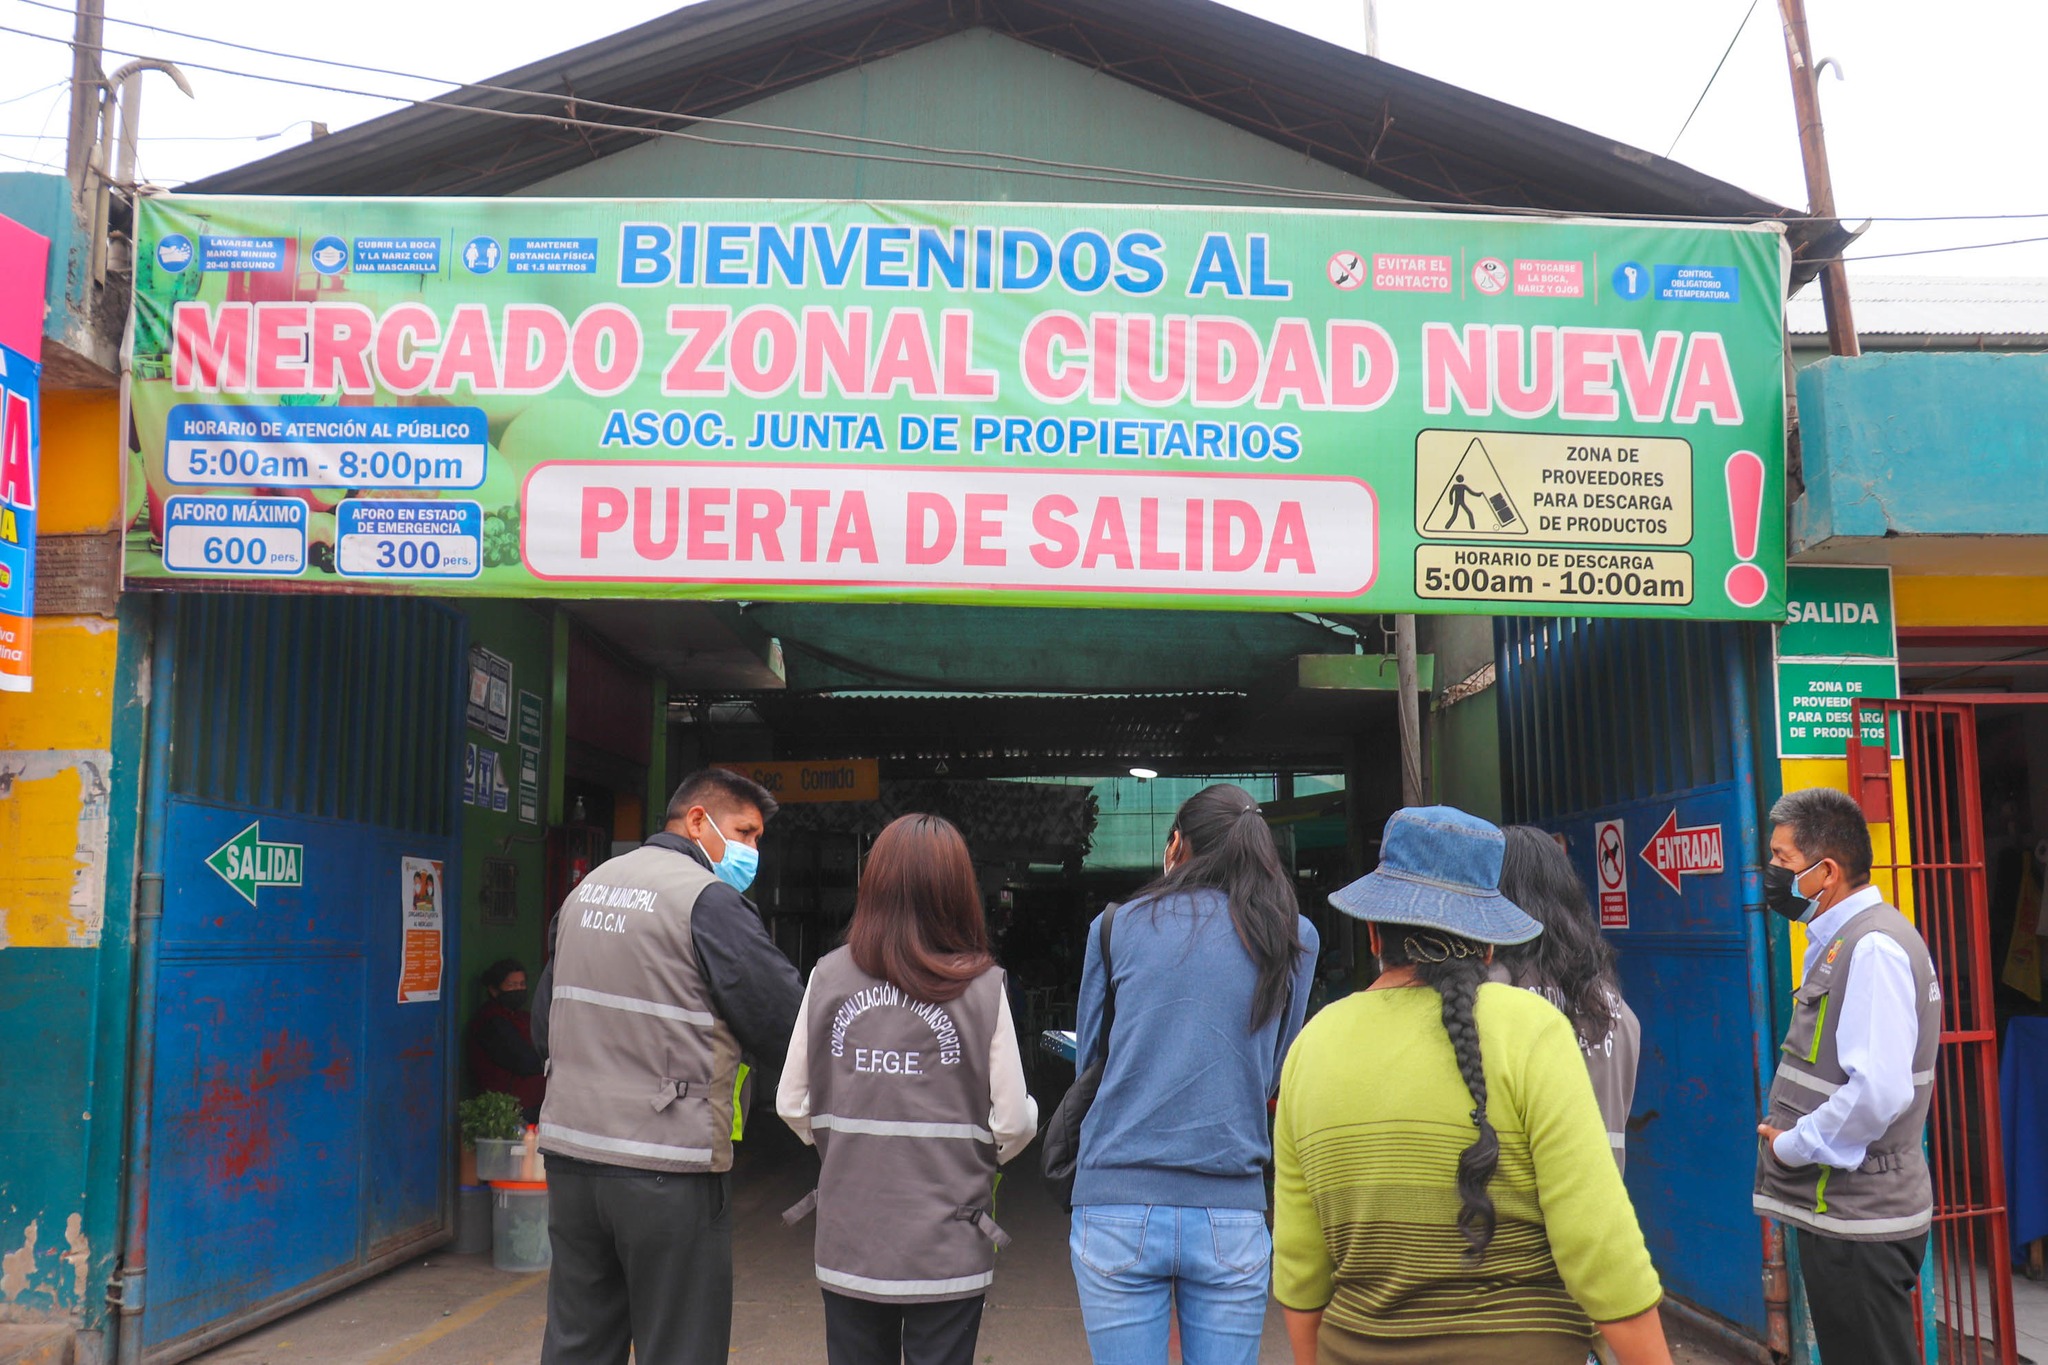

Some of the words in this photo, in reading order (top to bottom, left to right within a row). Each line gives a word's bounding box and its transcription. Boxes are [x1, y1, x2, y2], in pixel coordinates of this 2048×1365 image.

[211, 239, 252, 248] LAVARSE
[255, 240, 274, 249] LAS
[357, 241, 393, 249] CUBRIR
[395, 241, 408, 249] LA
[410, 241, 437, 249] BOCA
[526, 241, 580, 249] MANTENER
[206, 250, 239, 258] MANOS
[240, 250, 277, 259] MINIMO
[359, 252, 367, 260] Y
[368, 252, 380, 260] LA
[382, 252, 411, 260] NARIZ
[413, 252, 433, 260] CON
[509, 252, 561, 260] DISTANCIA
[563, 250, 595, 260] FÍSICA
[620, 223, 1166, 294] BIENVENIDOS
[1188, 234, 1290, 298] AL
[206, 261, 229, 269] 20-40
[230, 261, 275, 270] SEGUNDO
[355, 263, 375, 271] UNA
[377, 263, 437, 271] MASCARILLA
[516, 263, 529, 271] DE
[531, 263, 545, 271] 1.5
[547, 263, 587, 271] METROS
[1377, 258, 1426, 271] EVITAR
[1430, 259, 1446, 272] EL
[1519, 262, 1532, 271] NO
[1535, 263, 1576, 273] TOCARSE
[1376, 274, 1448, 289] CONTACTO
[1527, 274, 1540, 282] LA
[1678, 269, 1714, 279] CONTROL
[1517, 284, 1545, 293] NARIZ
[1546, 285, 1554, 293] Y
[1555, 285, 1580, 294] OJOS
[1671, 279, 1721, 289] OBLIGATORIO
[1663, 289, 1673, 298] DE
[1674, 289, 1730, 299] TEMPERATURA
[175, 303, 641, 397] MERCADO
[665, 307, 998, 399] ZONAL
[1022, 311, 1398, 411] CIUDAD
[1423, 322, 1744, 425] NUEVA
[184, 420, 257, 437] HORARIO
[261, 422, 282, 437] DE
[285, 420, 367, 438] ATENCIÓN
[371, 423, 393, 438] AL
[397, 420, 470, 438] PÚBLICO
[601, 411, 735, 447] ASOC.
[747, 412, 885, 451] JUNTA
[899, 416, 960, 453] DE
[974, 417, 1301, 461] PROPIETARIOS
[1566, 446, 1612, 463] ZONA
[1618, 448, 1640, 463] DE
[188, 448, 309, 477] 5:00am
[339, 450, 463, 484] 8:00pm
[1541, 469, 1664, 487] PROVEEDORES
[1533, 492, 1578, 509] PARA
[1583, 493, 1673, 512] DESCARGA
[171, 503, 227, 521] AFORO
[232, 501, 301, 523] MÁXIMO
[352, 508, 395, 520] AFORO
[398, 509, 415, 520] EN
[418, 509, 467, 521] ESTADO
[357, 522, 375, 533] DE
[378, 522, 461, 534] EMERGENCIA
[580, 486, 879, 565] PUERTA
[905, 491, 1008, 567] DE
[1029, 493, 1317, 575] SALIDA
[1539, 516, 1561, 531] DE
[1566, 516, 1668, 534] PRODUCTOS
[203, 537, 267, 564] 600
[270, 553, 299, 565] pers.
[376, 540, 440, 568] 300
[443, 555, 472, 567] pers.
[1454, 551, 1531, 567] HORARIO
[1537, 552, 1559, 568] DE
[1564, 553, 1654, 570] DESCARGA
[1425, 567, 1533, 593] 5:00am
[1559, 571, 1684, 597] 10:00am
[1786, 601, 1879, 624] SALIDA
[1808, 681, 1843, 692] ZONA
[1846, 682, 1862, 692] DE
[1793, 696, 1852, 707] PROVEED
[1788, 711, 1822, 722] PARA
[1790, 727, 1806, 738] DE
[1813, 727, 1885, 738] PRODUTOS
[1655, 832, 1721, 870] ENTRADA
[226, 844, 297, 881] SALIDA
[606, 887, 658, 912] MUNICIPAL
[580, 909, 626, 933] M.D.C.N.
[831, 981, 899, 1058] COMERCIALIZACIÓN
[902, 994, 909, 1008] Y
[910, 1000, 961, 1065] TRANSPORTES
[855, 1048, 924, 1075] E.F.G.E.
